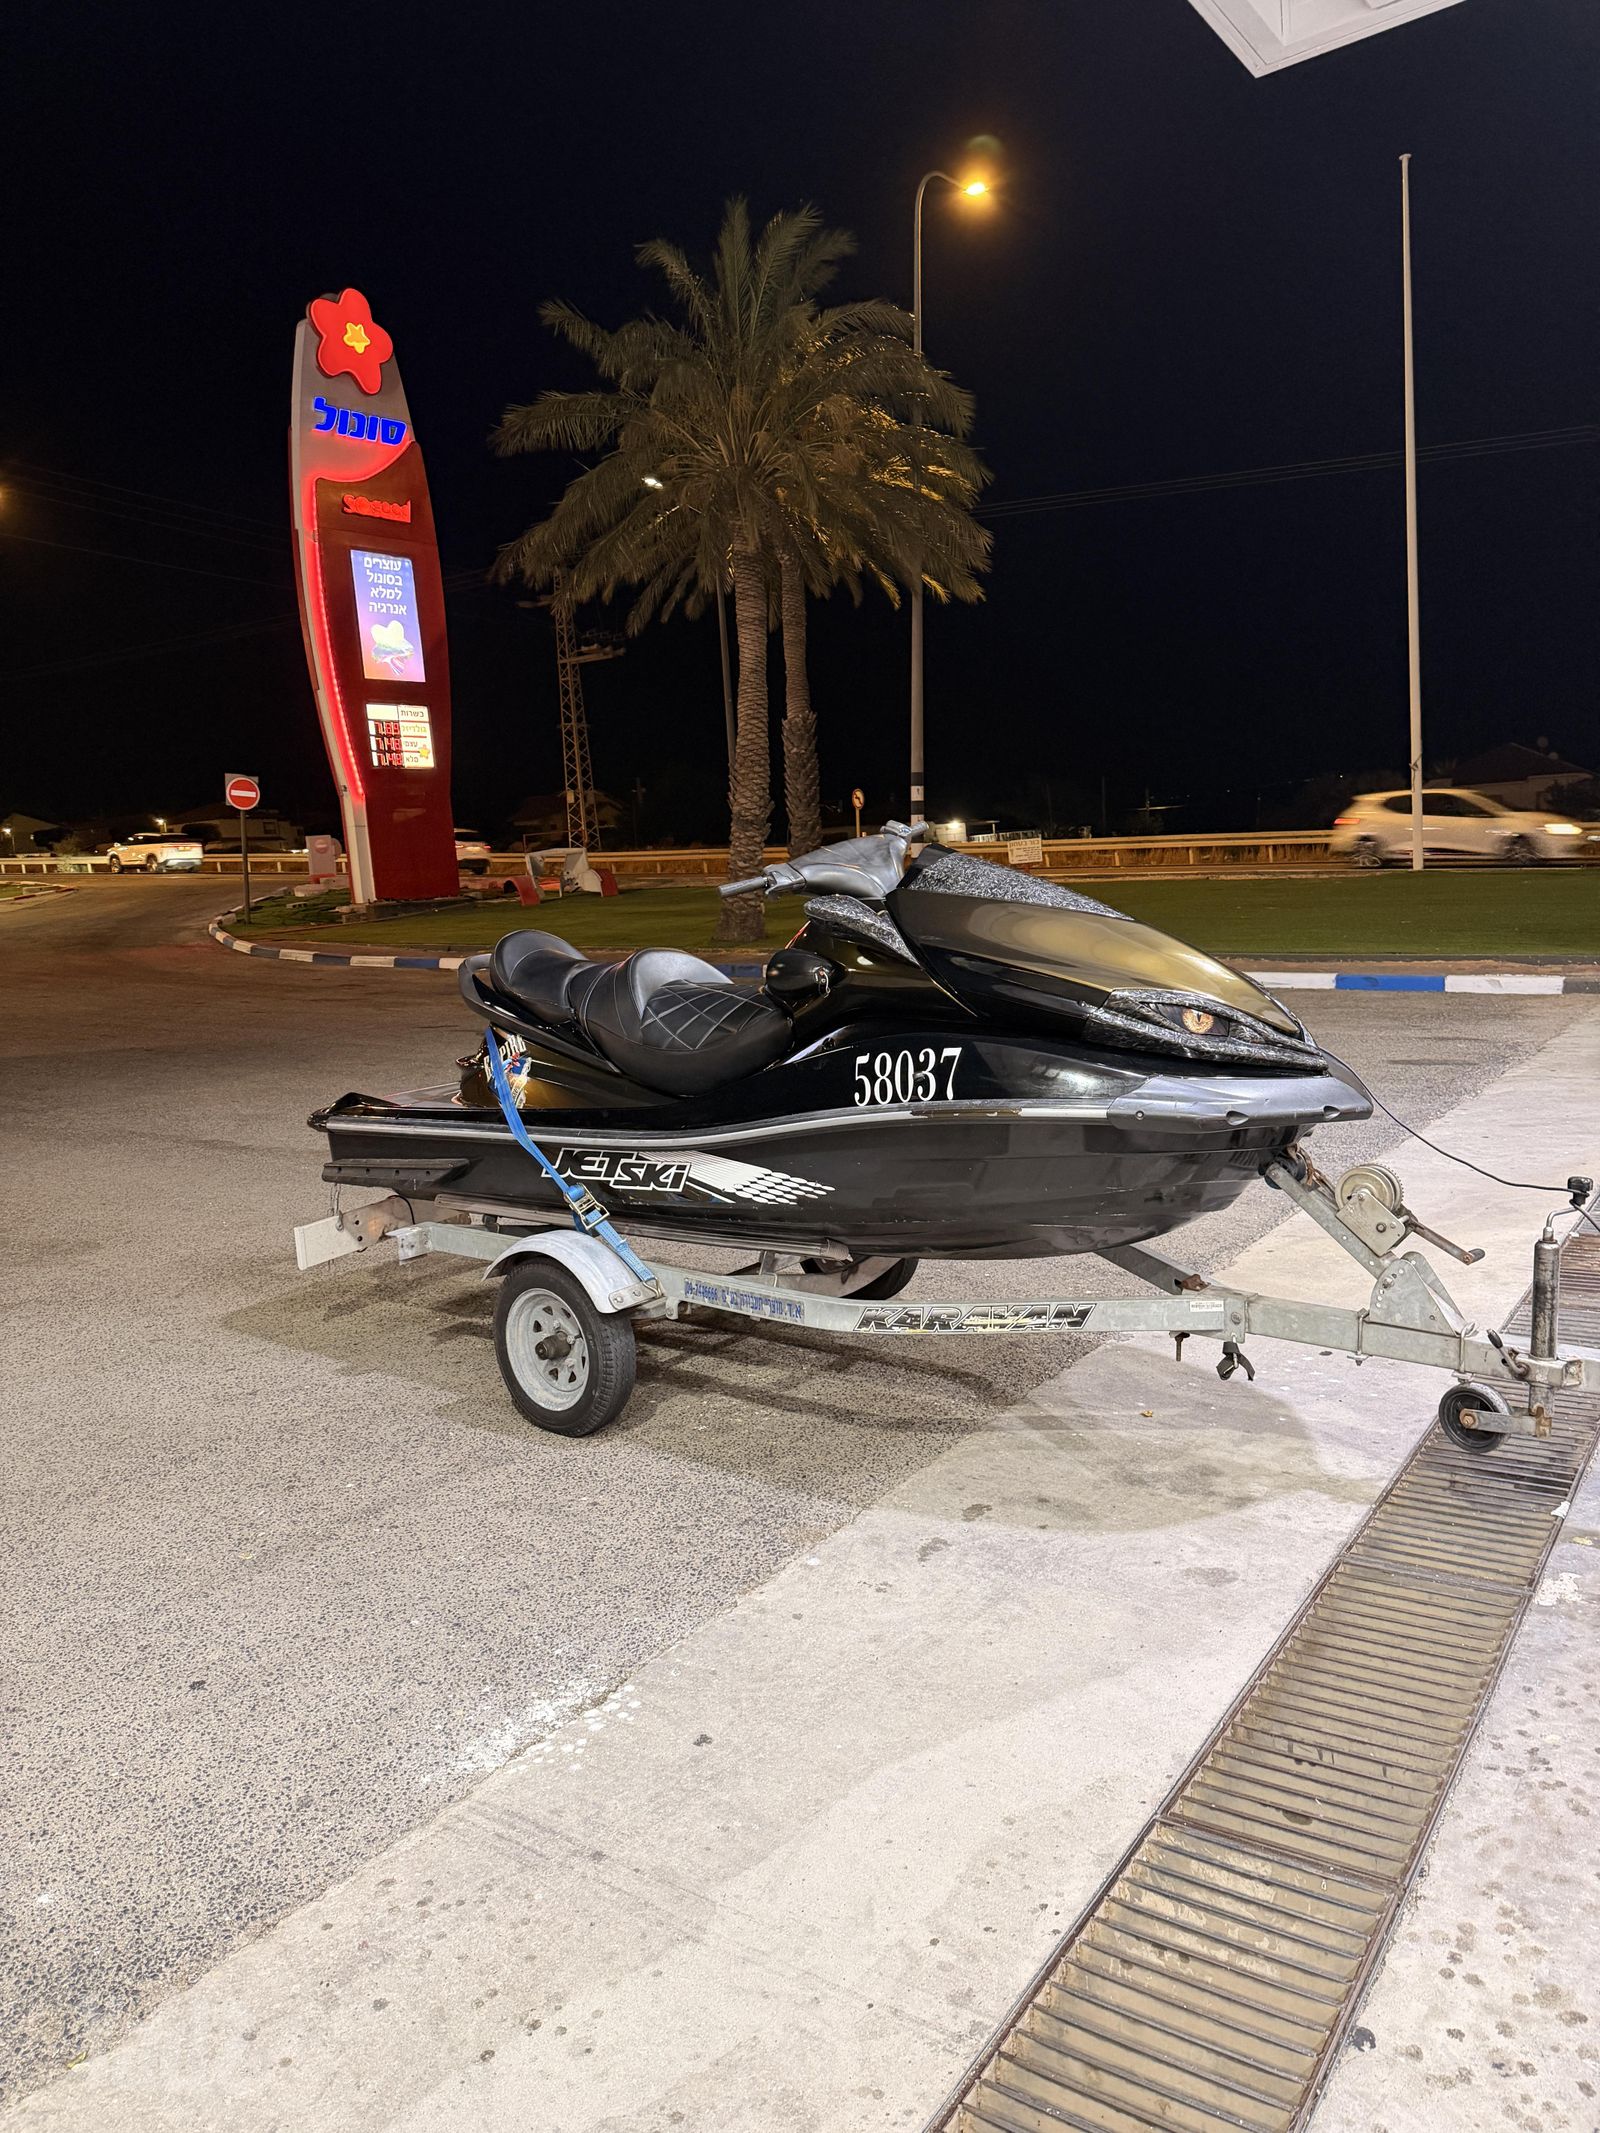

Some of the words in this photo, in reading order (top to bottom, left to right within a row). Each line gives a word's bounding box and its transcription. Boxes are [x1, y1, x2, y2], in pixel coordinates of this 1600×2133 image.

[313, 396, 408, 446] סונול
[363, 557, 402, 571] עוצרים
[366, 569, 403, 586] בסונול
[370, 585, 402, 600] למלא
[368, 602, 407, 615] אנרגיה
[854, 1047, 962, 1107] 58037
[852, 1303, 1097, 1332] KARAVAN
